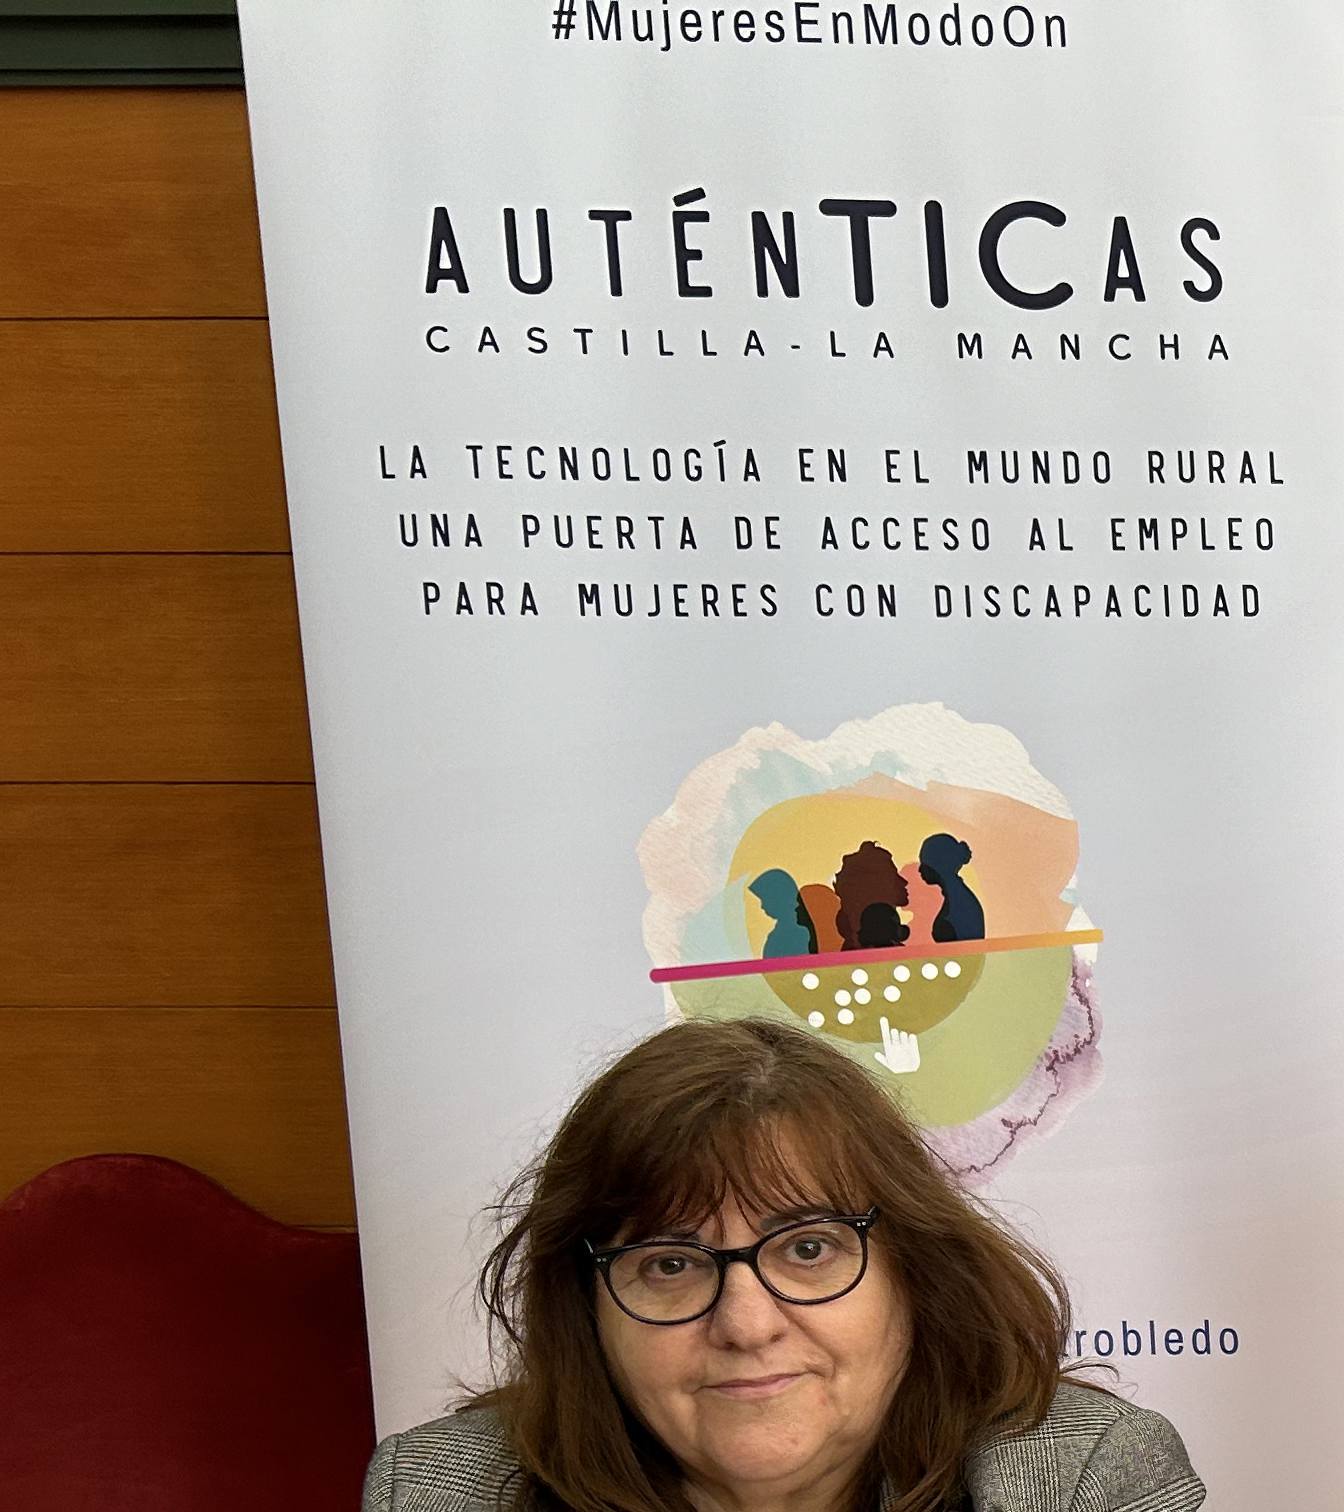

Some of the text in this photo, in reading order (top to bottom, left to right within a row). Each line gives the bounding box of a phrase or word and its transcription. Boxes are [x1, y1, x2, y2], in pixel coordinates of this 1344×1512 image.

[551, 0, 1067, 51] #MujeresEnModoOn
[425, 187, 1224, 311] AUTÉNTICAS
[957, 332, 1229, 361] MANCHA
[379, 439, 1284, 485] LA TECNOLOGÍA EN EL MUNDO RURAL
[399, 513, 1275, 551] UNA PUERTA DE ACCESO AL EMPLEO
[422, 581, 1260, 618] PARA MUJERES CON DISCAPACIDAD
[1074, 1319, 1240, 1357] robledo
